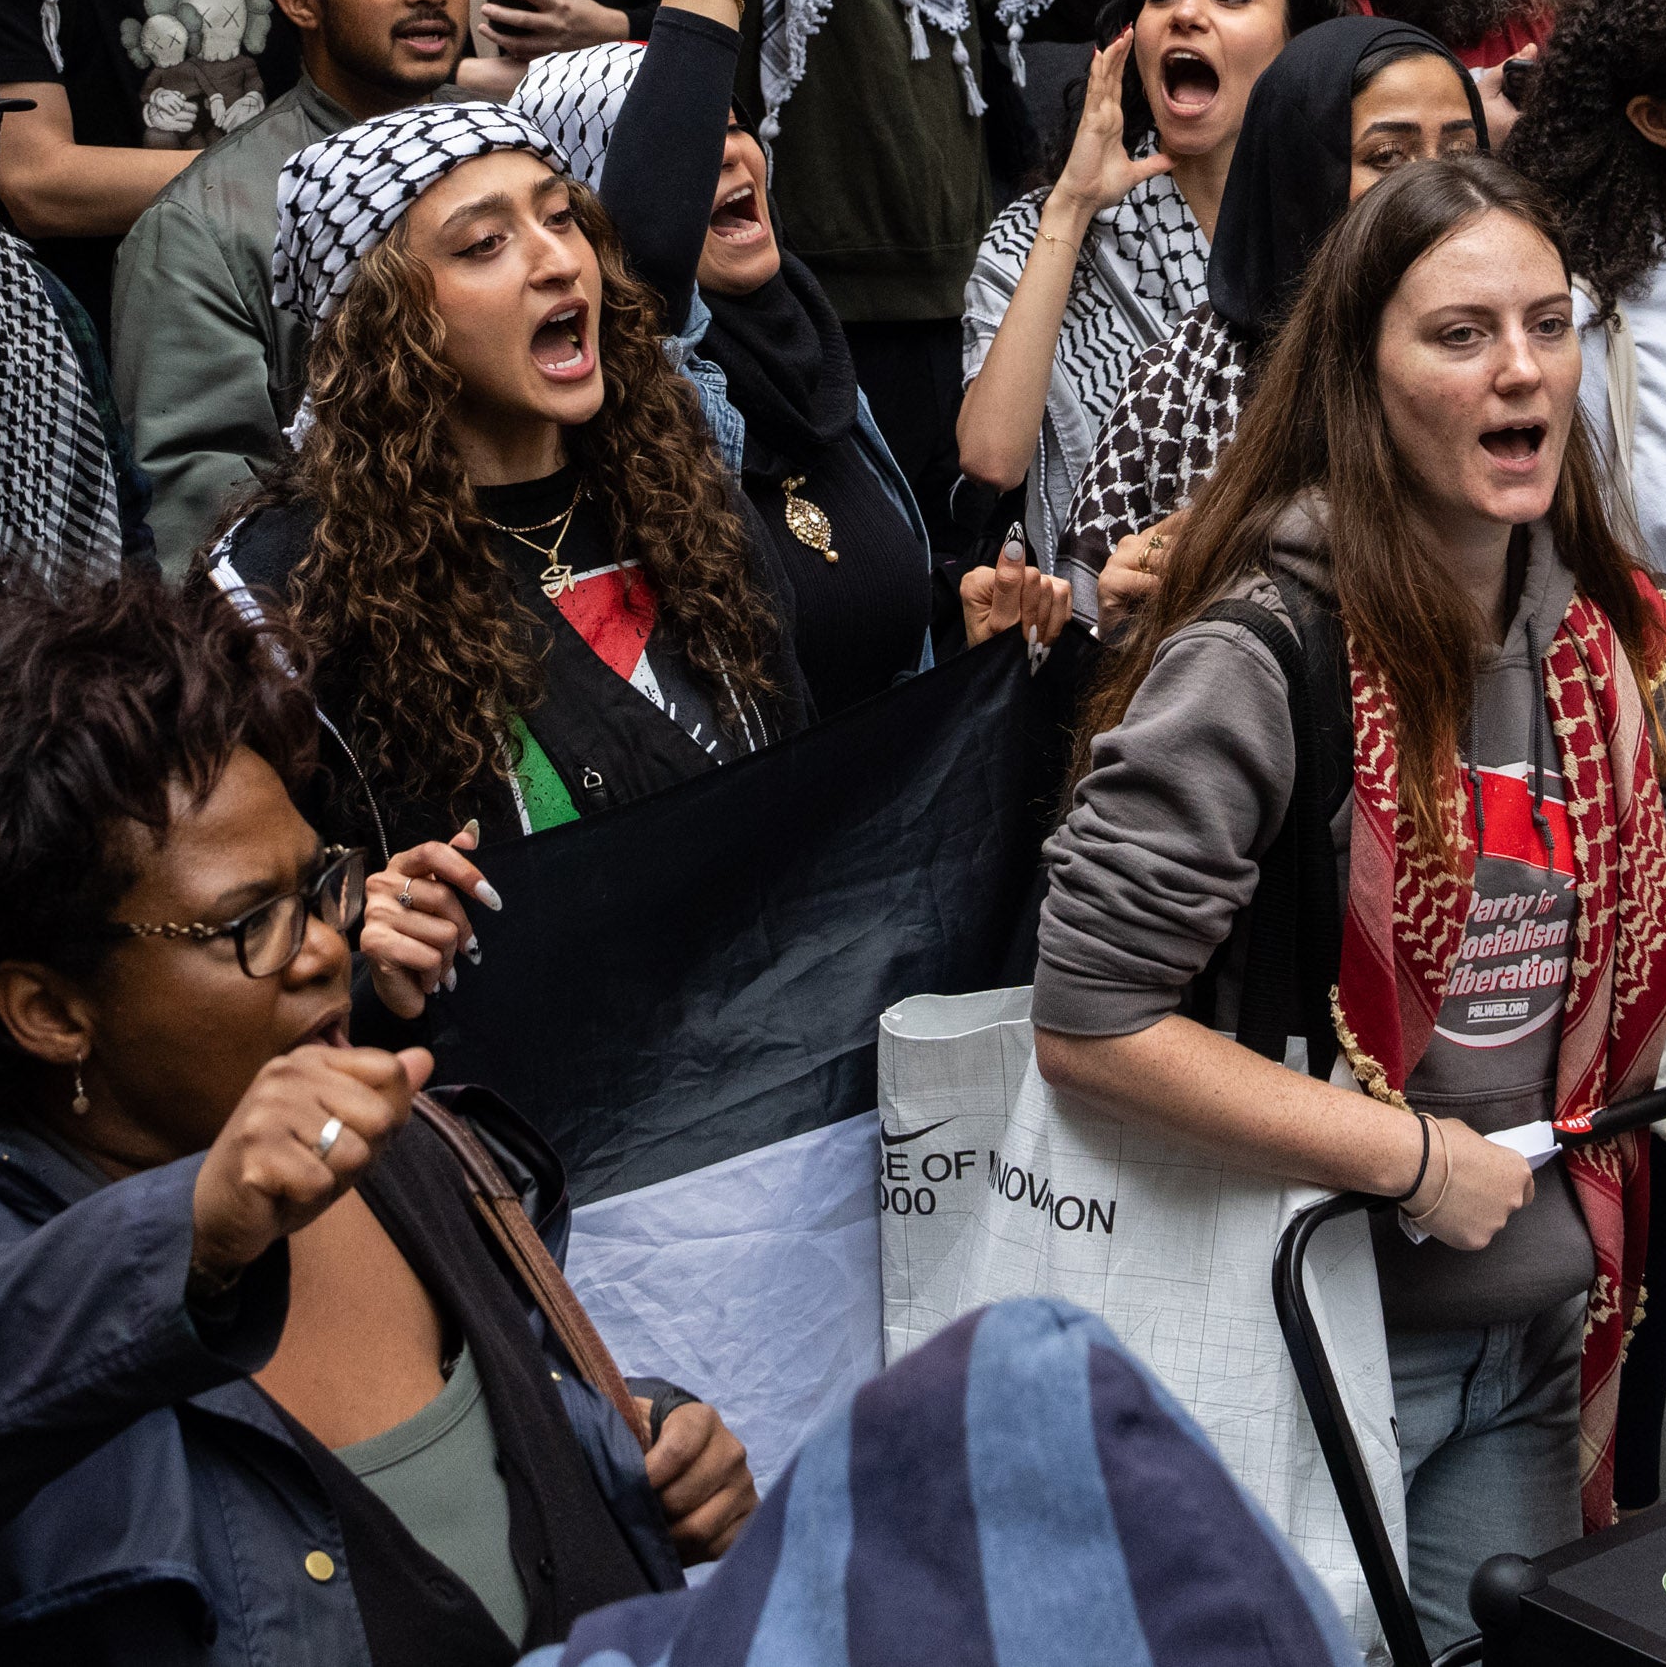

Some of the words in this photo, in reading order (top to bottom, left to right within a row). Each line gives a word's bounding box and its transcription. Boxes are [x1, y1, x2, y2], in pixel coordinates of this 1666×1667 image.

[1468, 890, 1536, 923] Party
[1457, 919, 1569, 961] ocialism
[1447, 954, 1569, 995] iberation
[1467, 1001, 1529, 1019] PSLWEB.ORG
[921, 1149, 976, 1182] OF
